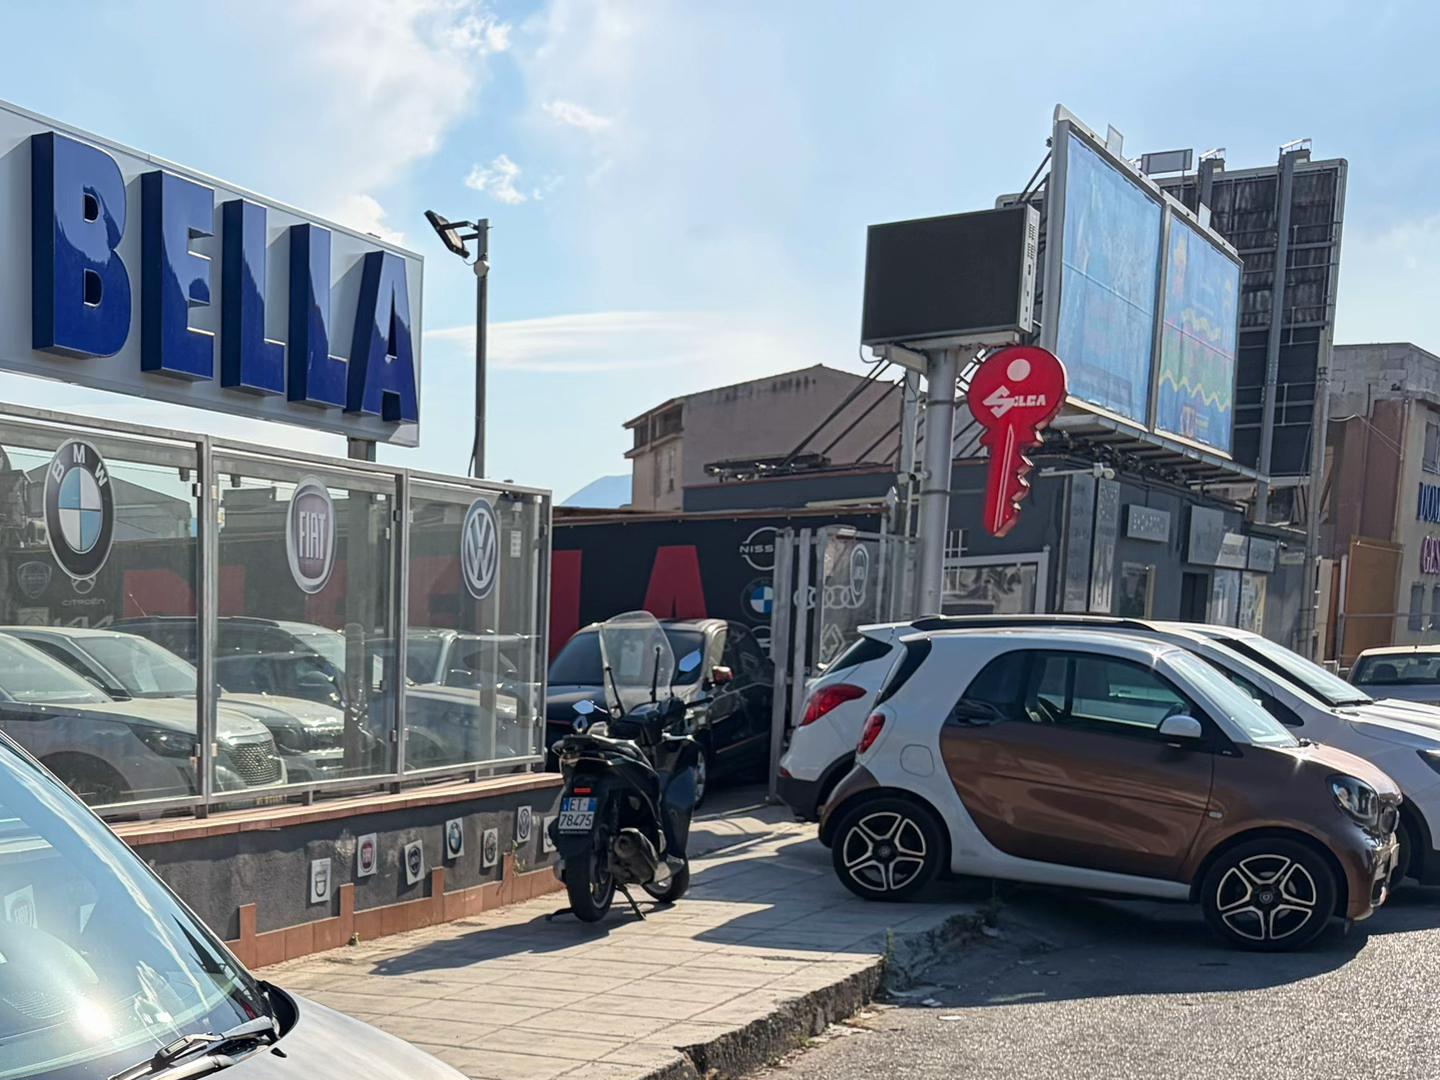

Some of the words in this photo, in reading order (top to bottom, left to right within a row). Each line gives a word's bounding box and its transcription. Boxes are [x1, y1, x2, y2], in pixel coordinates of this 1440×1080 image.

[31, 132, 418, 424] BELLA
[51, 444, 108, 487] BMW
[299, 511, 326, 560] FIAT
[739, 545, 775, 553] NISS
